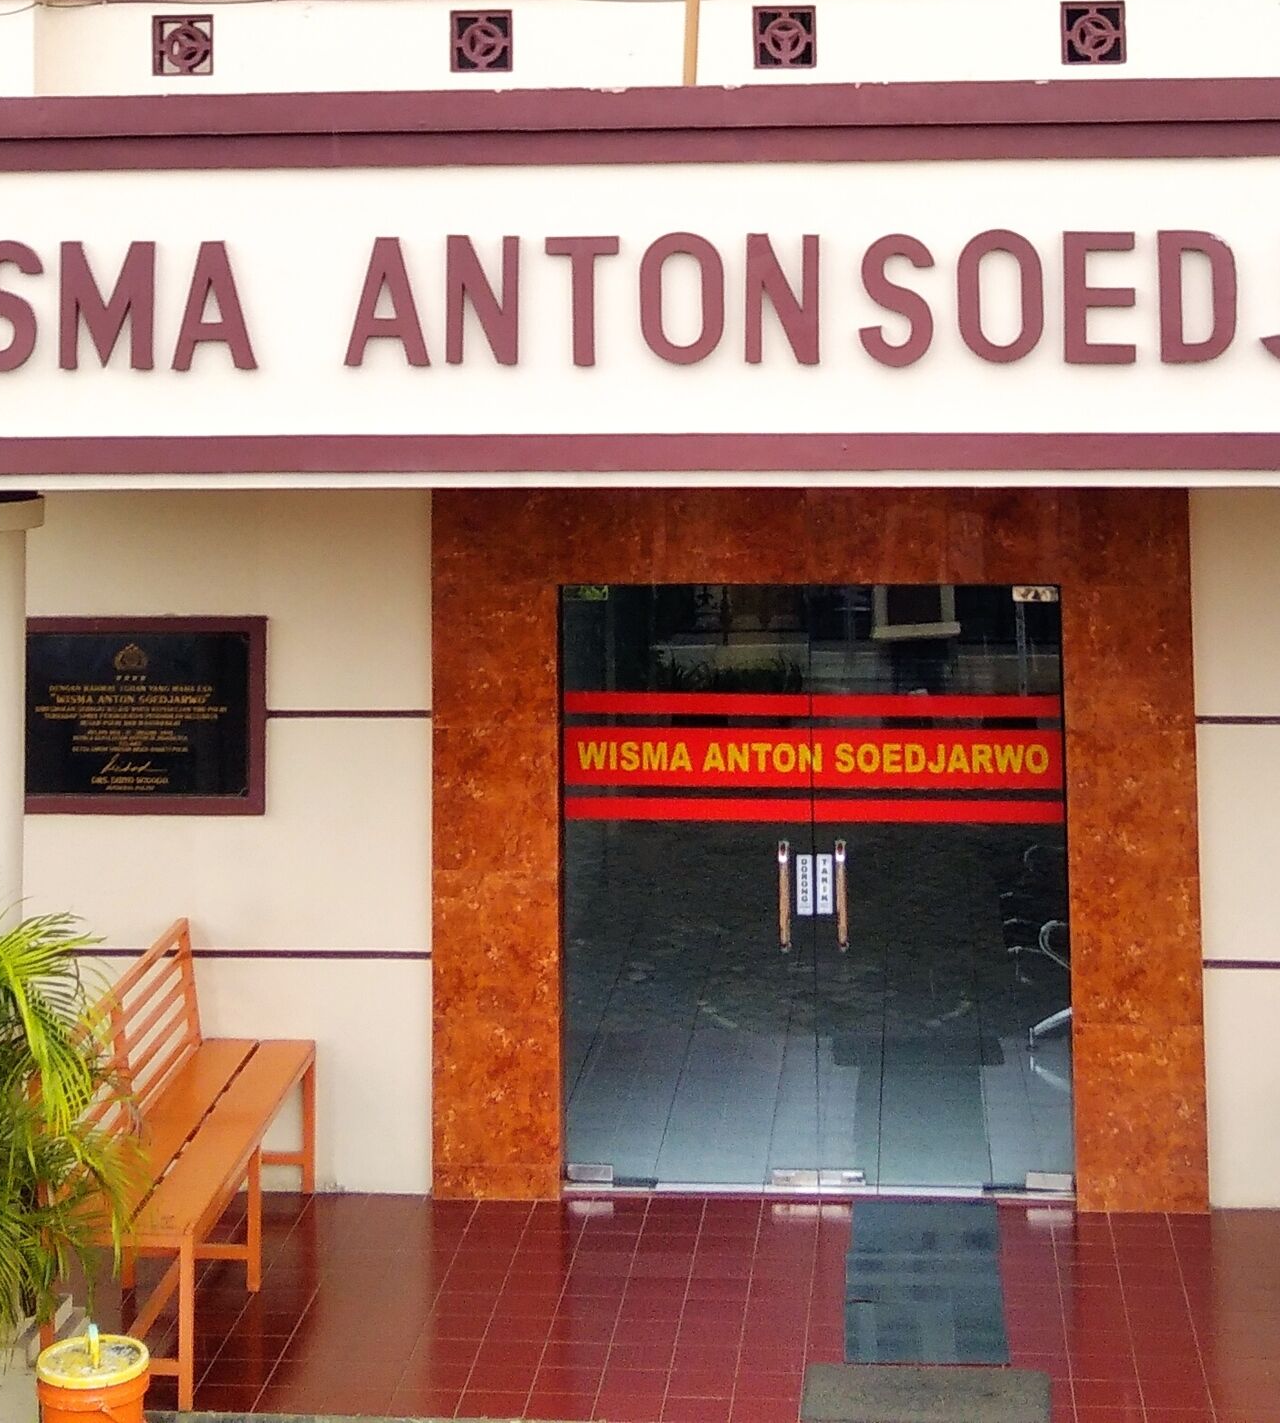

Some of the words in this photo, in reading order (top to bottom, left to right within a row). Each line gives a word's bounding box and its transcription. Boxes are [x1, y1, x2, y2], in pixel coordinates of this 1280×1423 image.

[342, 231, 821, 368] ANTON
[577, 741, 693, 771] WISMA
[702, 742, 824, 772] ANTON
[834, 742, 1050, 774] SOEDJARWO
